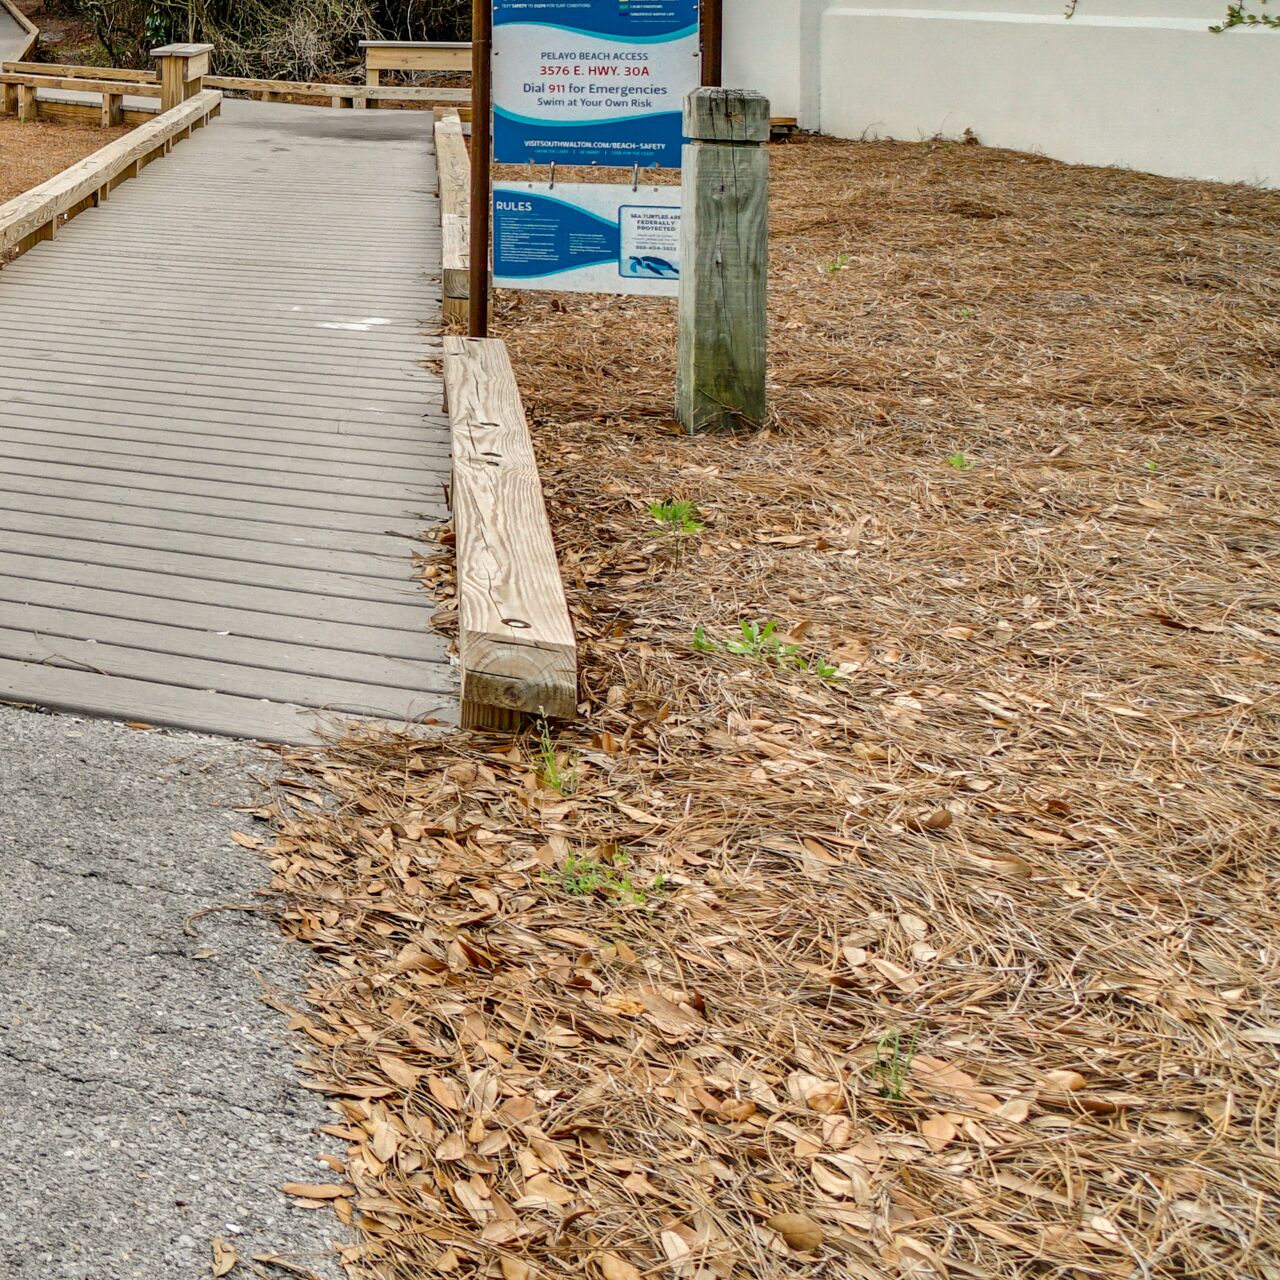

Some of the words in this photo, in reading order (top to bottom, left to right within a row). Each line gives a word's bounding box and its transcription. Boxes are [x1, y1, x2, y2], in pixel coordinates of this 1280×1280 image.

[540, 66, 569, 76] 3576
[574, 66, 584, 76] E.
[588, 66, 620, 76] HWY.
[624, 67, 649, 76] 30A
[523, 83, 544, 93] Dial
[548, 84, 565, 93] 911
[568, 83, 585, 93] for
[589, 84, 667, 97] Emergencies
[537, 98, 564, 106] Swim
[580, 98, 601, 107] Your
[605, 99, 628, 107] Own
[631, 99, 652, 108] Risk
[524, 140, 666, 150] VISITSOUTHWALTON.COM/BEACH-SAFETY
[496, 201, 532, 211] RULES
